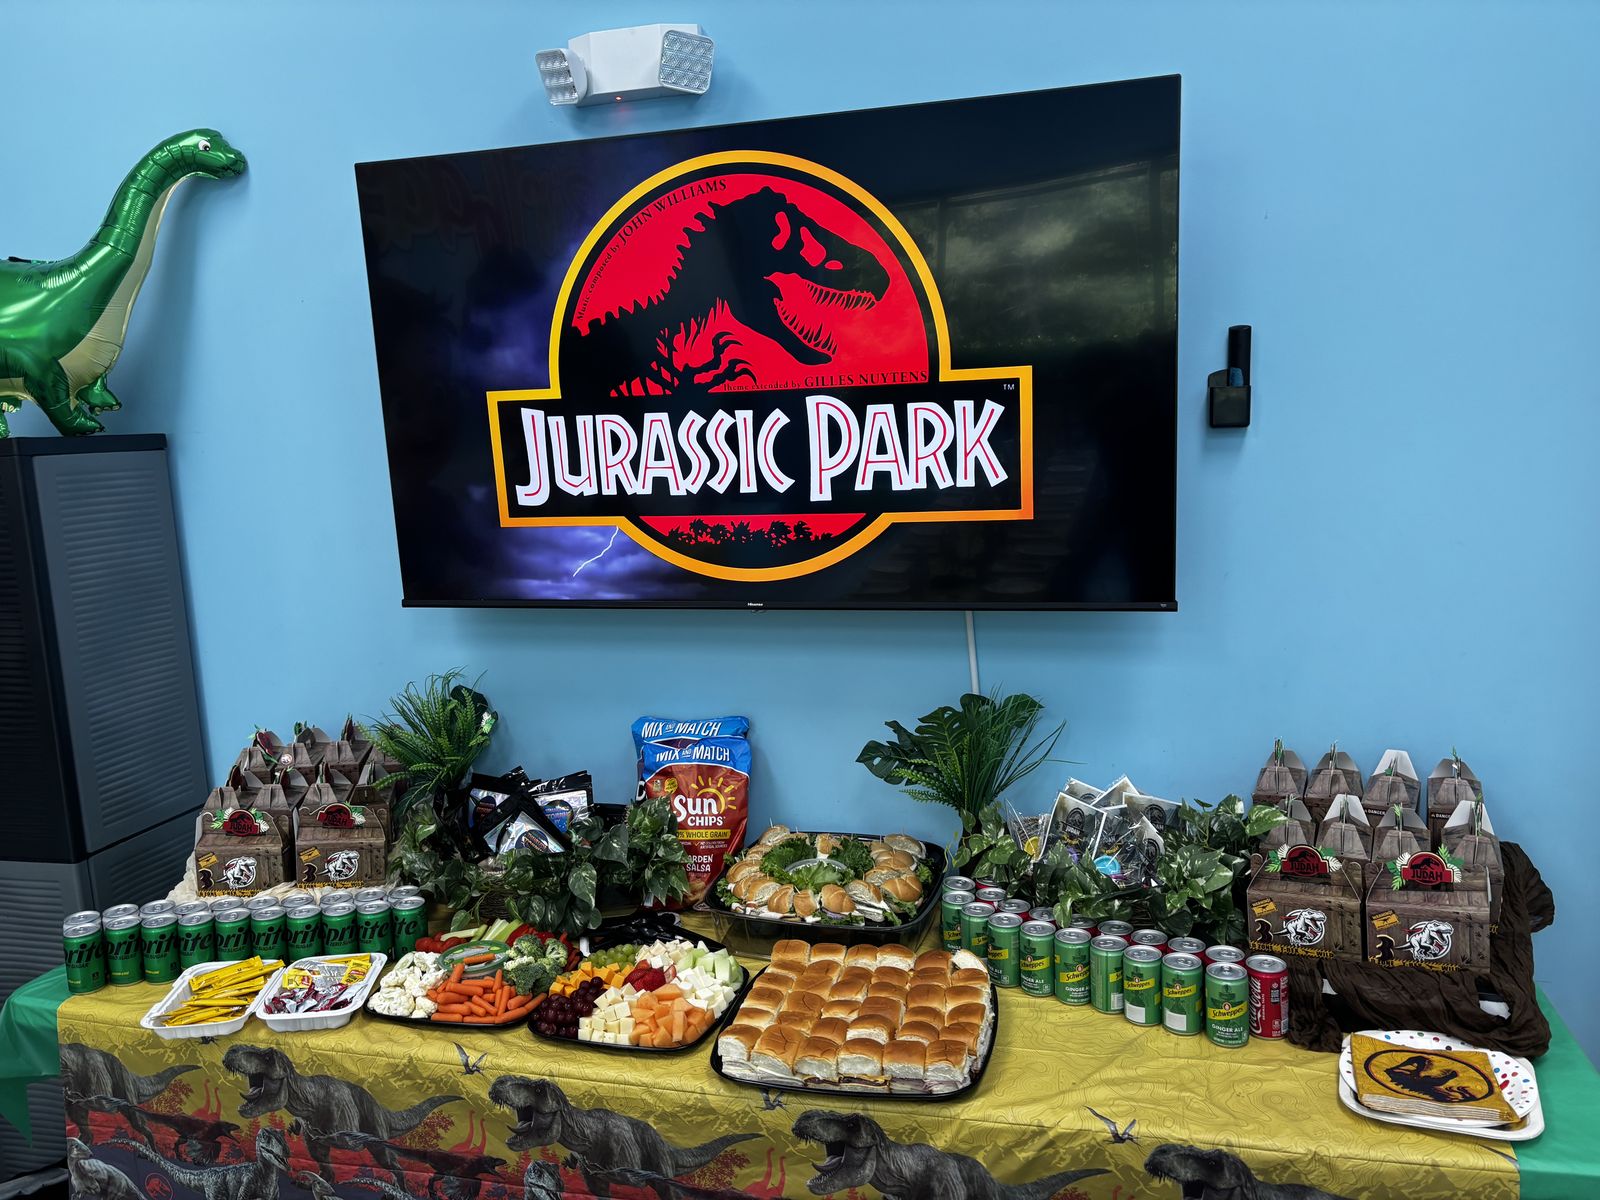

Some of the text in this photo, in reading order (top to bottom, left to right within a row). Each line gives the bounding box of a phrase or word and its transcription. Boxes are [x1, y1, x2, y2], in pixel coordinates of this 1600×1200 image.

[577, 178, 727, 321] Music composed by JOHN WILLIAMS
[751, 381, 789, 390] extended
[791, 381, 803, 390] by
[804, 374, 854, 388] GILLES
[859, 370, 928, 385] NUYTENS
[515, 395, 1008, 507] JURASSIC PARK
[641, 721, 722, 738] MIX AND MATCH
[656, 744, 730, 762] MIX AND MATCH
[673, 794, 719, 823] Sun
[230, 821, 252, 832] JUDAH
[687, 816, 723, 826] CHIPS
[688, 853, 713, 863] ARDEN
[686, 864, 711, 872] SALSA
[1290, 862, 1320, 873] JUDAH
[1411, 869, 1443, 881] JUDAH
[1127, 981, 1151, 989] Schweppes
[1167, 988, 1192, 996] Schweppes
[1212, 1007, 1244, 1018] Schweppes
[1211, 1023, 1233, 1033] GINGER
